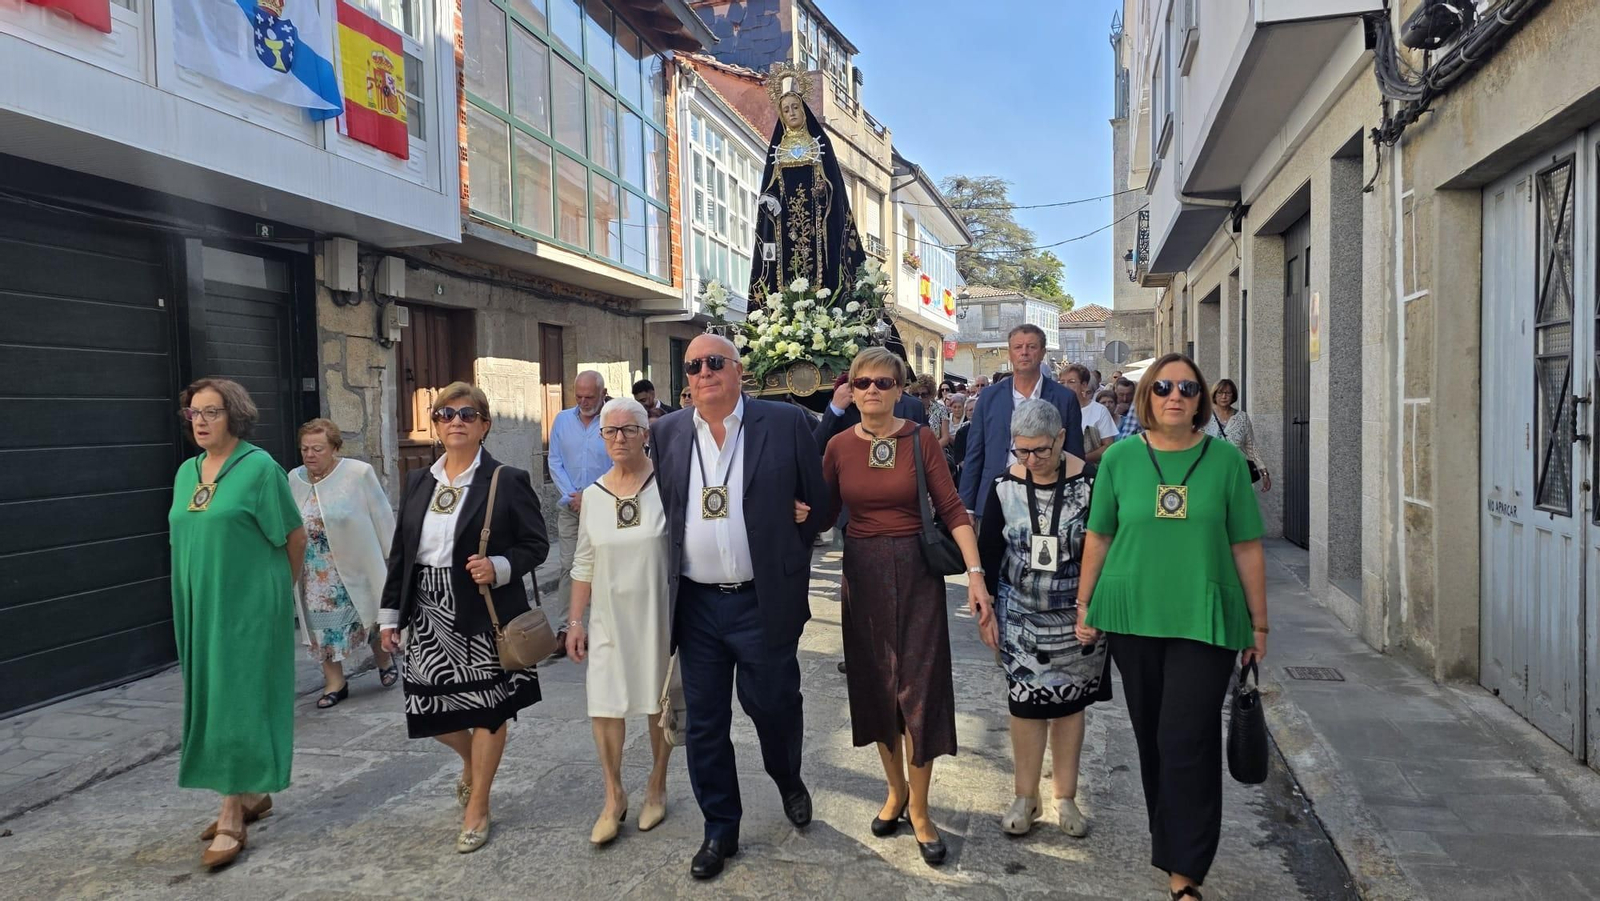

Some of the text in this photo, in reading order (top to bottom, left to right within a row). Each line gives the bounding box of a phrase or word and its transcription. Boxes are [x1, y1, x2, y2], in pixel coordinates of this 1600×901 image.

[437, 284, 443, 295] 6
[1487, 498, 1518, 518] NO APARCAR
